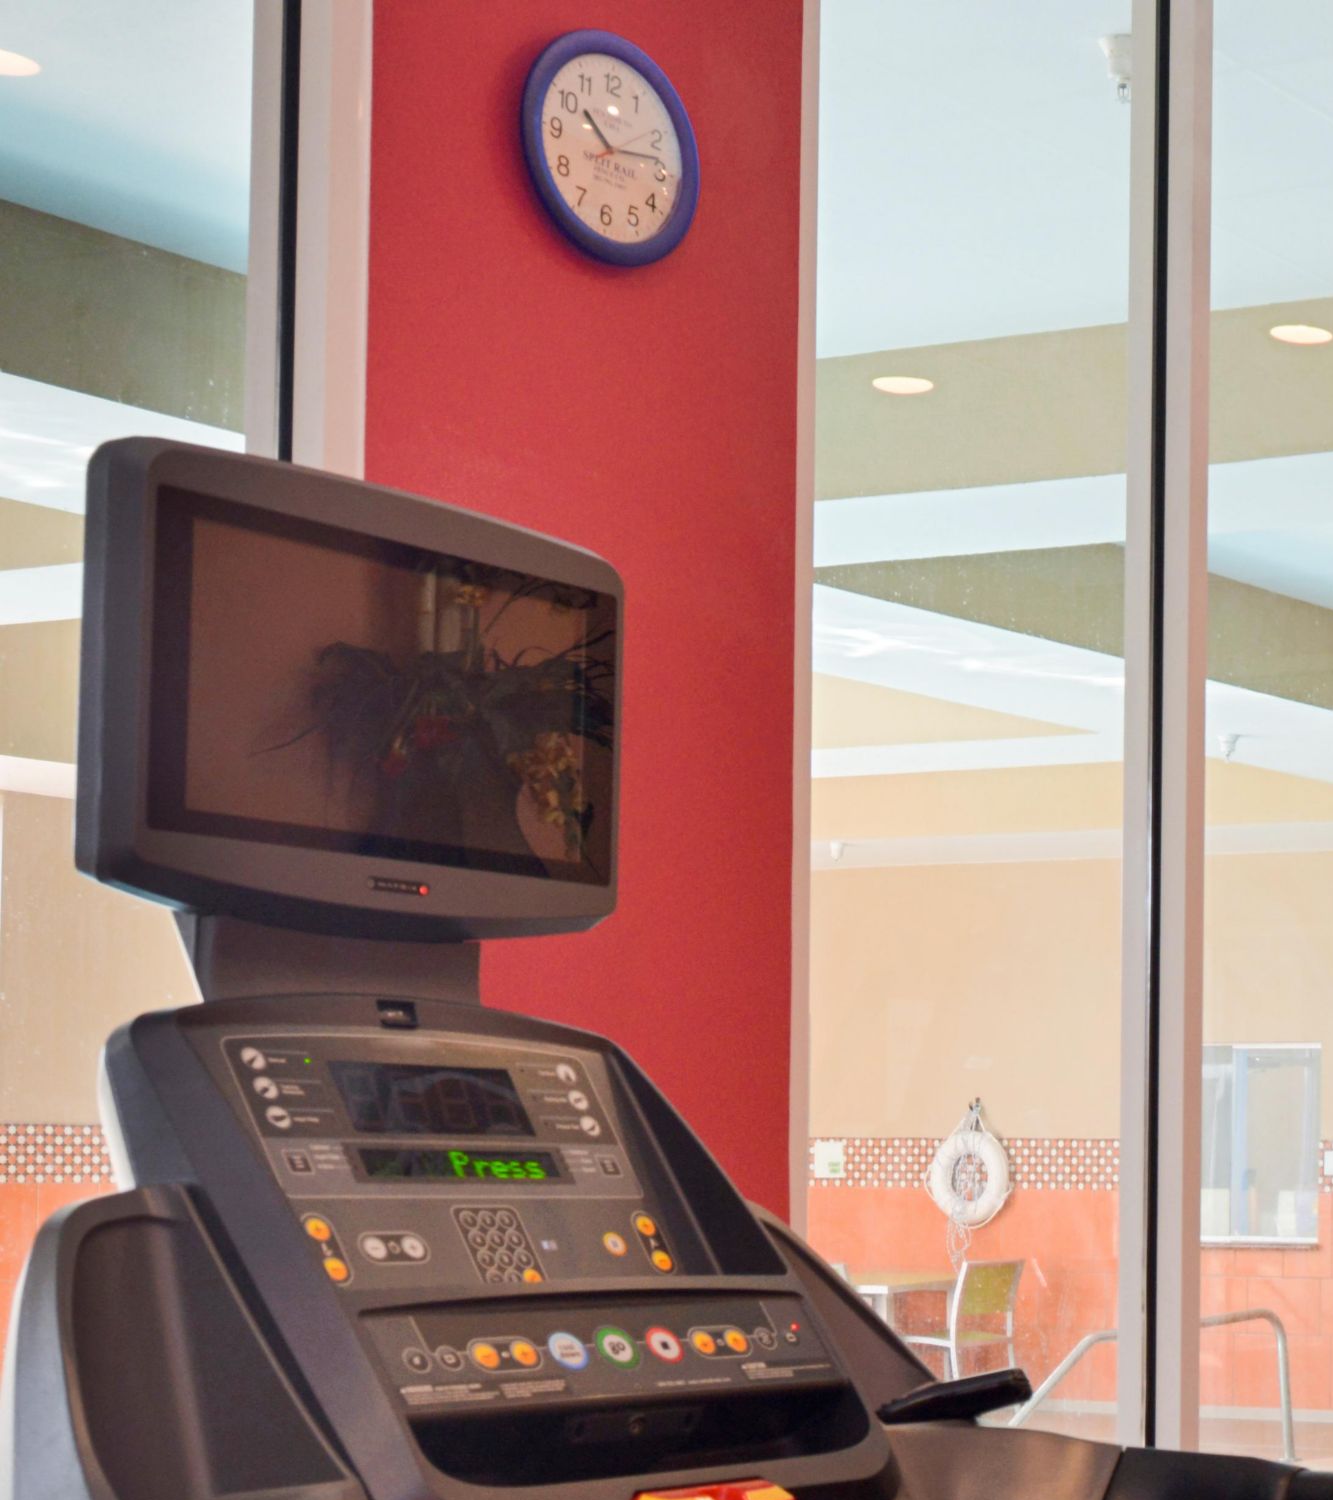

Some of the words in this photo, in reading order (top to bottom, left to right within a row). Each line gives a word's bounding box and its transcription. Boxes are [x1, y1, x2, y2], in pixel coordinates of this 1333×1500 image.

[578, 74, 592, 96] 11
[604, 73, 622, 98] 12
[558, 89, 579, 115] 10
[632, 95, 639, 114] 1
[550, 116, 563, 139] 9
[650, 128, 663, 151] 2
[556, 155, 570, 178] 8
[614, 161, 637, 179] RAIL
[654, 158, 667, 182] 3
[575, 185, 588, 208] 7
[645, 192, 658, 214] 4
[600, 204, 613, 227] 6
[627, 205, 641, 228] 5
[447, 1150, 546, 1179] Press
